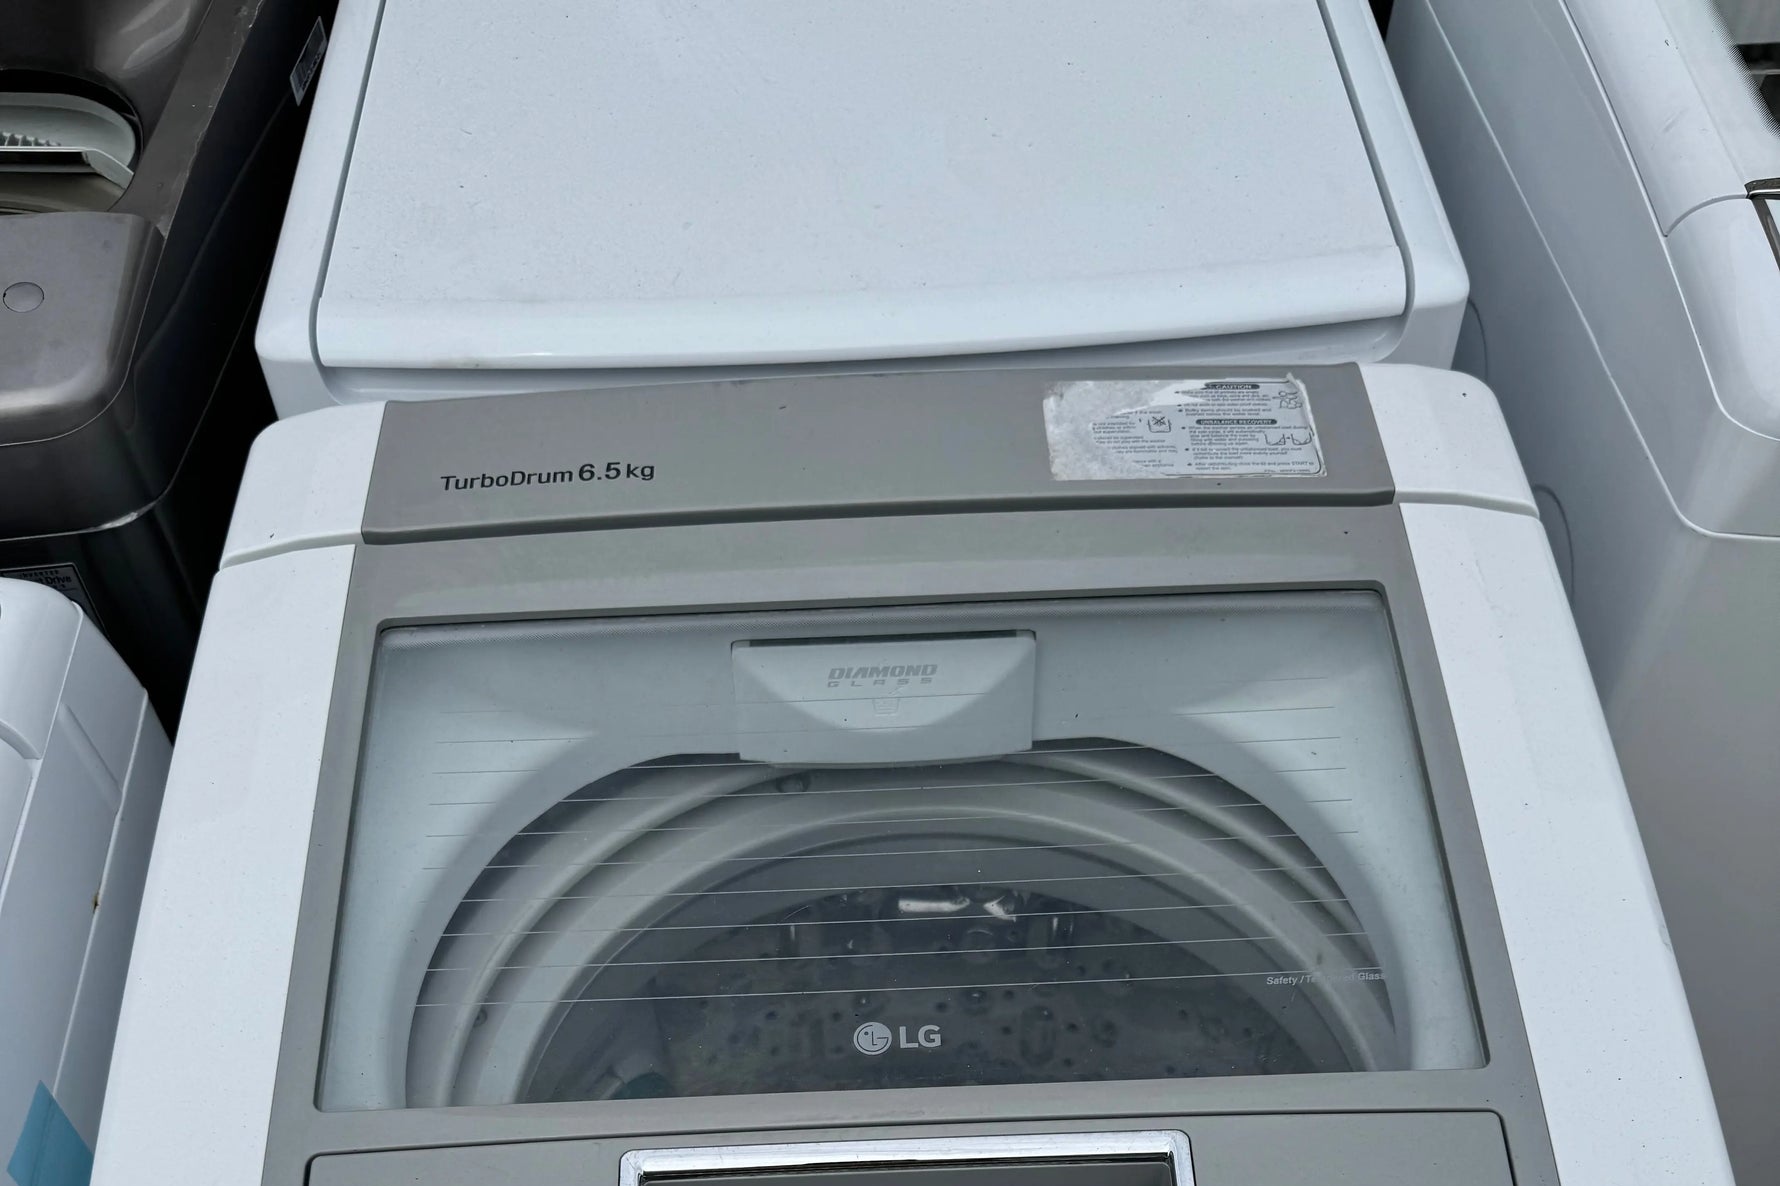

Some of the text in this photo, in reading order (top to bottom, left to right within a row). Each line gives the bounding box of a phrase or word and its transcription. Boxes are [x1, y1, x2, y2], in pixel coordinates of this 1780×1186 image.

[440, 461, 655, 491] TurboDrum 6.5 kg
[827, 664, 938, 680] DIAMOND
[1266, 975, 1298, 986] Safety
[1357, 972, 1386, 981] Glass
[899, 1024, 942, 1049] LG
